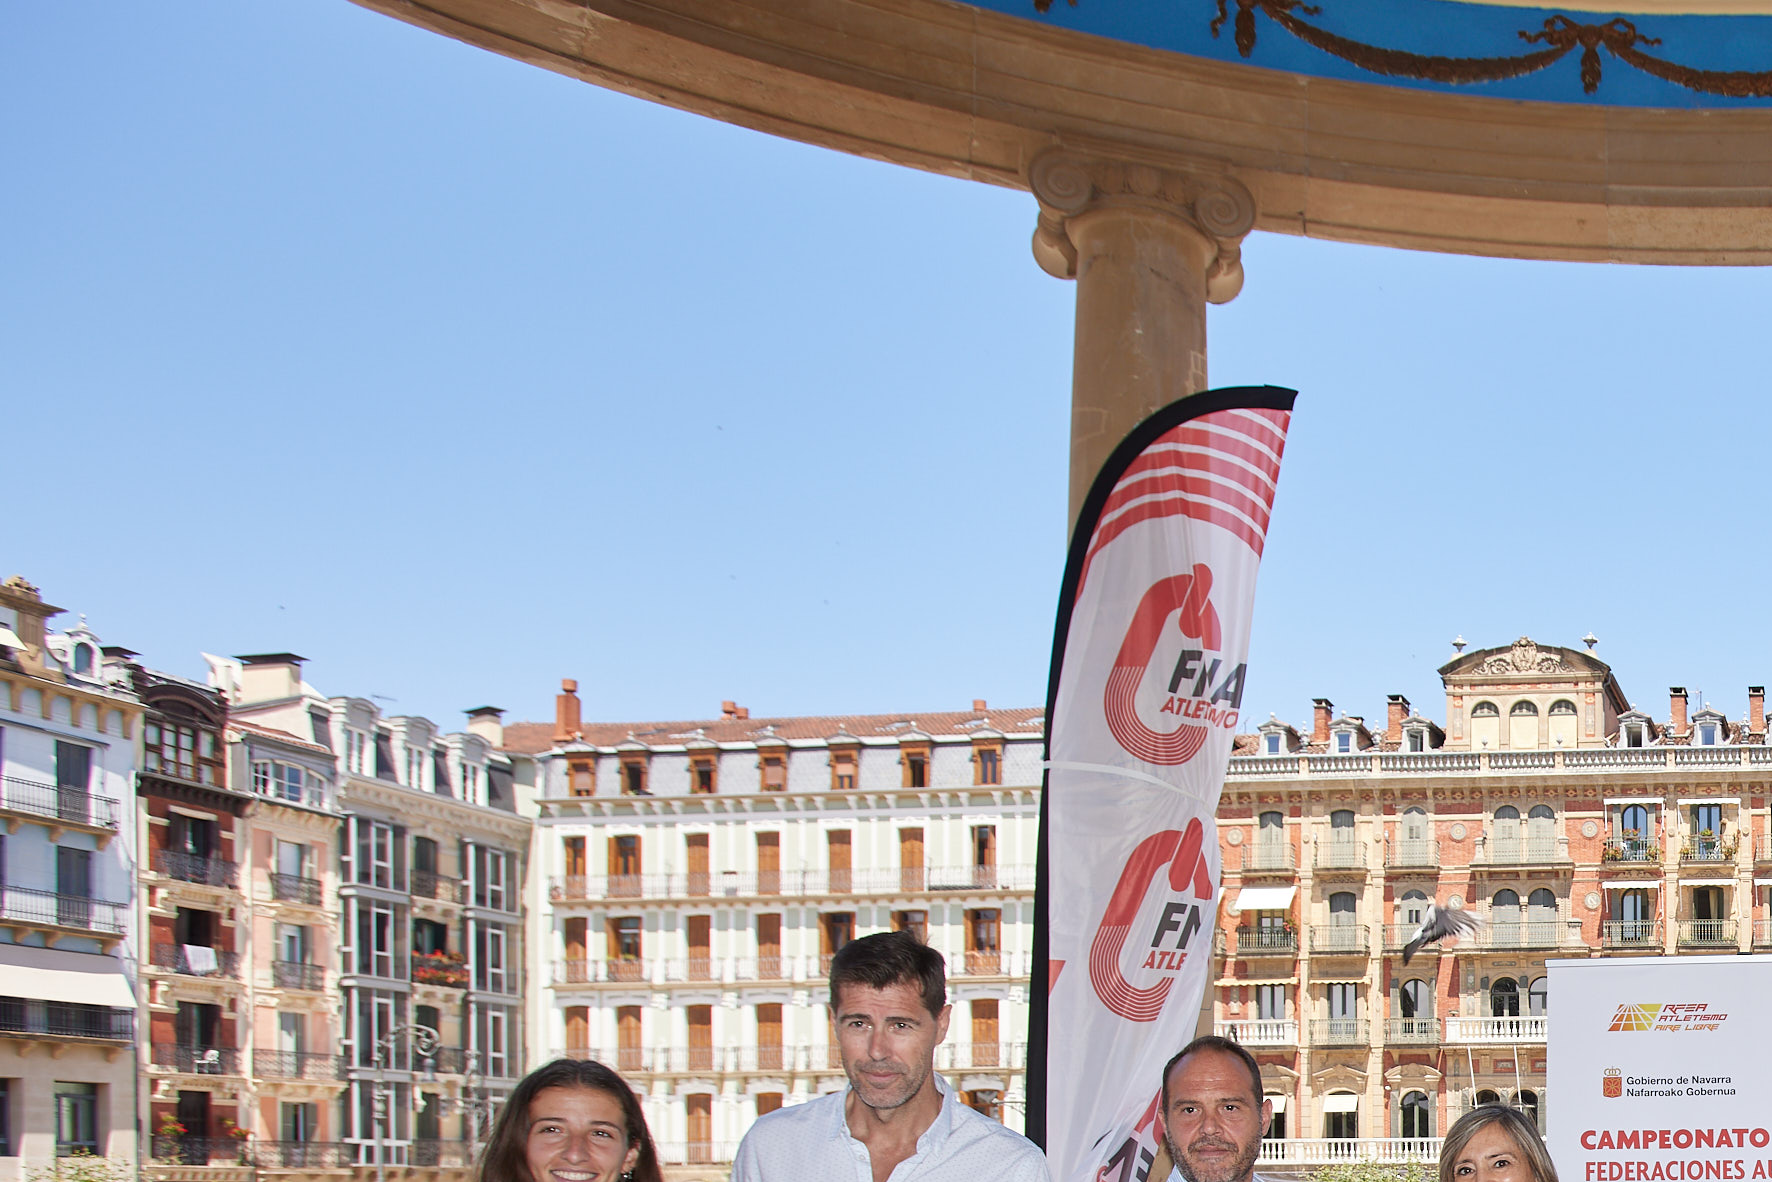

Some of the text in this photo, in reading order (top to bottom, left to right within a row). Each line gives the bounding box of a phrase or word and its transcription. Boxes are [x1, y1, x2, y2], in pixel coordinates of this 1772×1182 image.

[1151, 902, 1201, 949] FN
[1663, 1003, 1708, 1014] RFEA
[1658, 1014, 1728, 1022] ATLETISMO
[1654, 1023, 1720, 1032] AIRE LIBRE
[1627, 1075, 1732, 1085] Gobierno de Navarra
[1627, 1087, 1736, 1097] Nafarroako Gobernua
[1580, 1128, 1770, 1150] CAMPEONATO
[1585, 1160, 1745, 1181] FEDERACIONES
